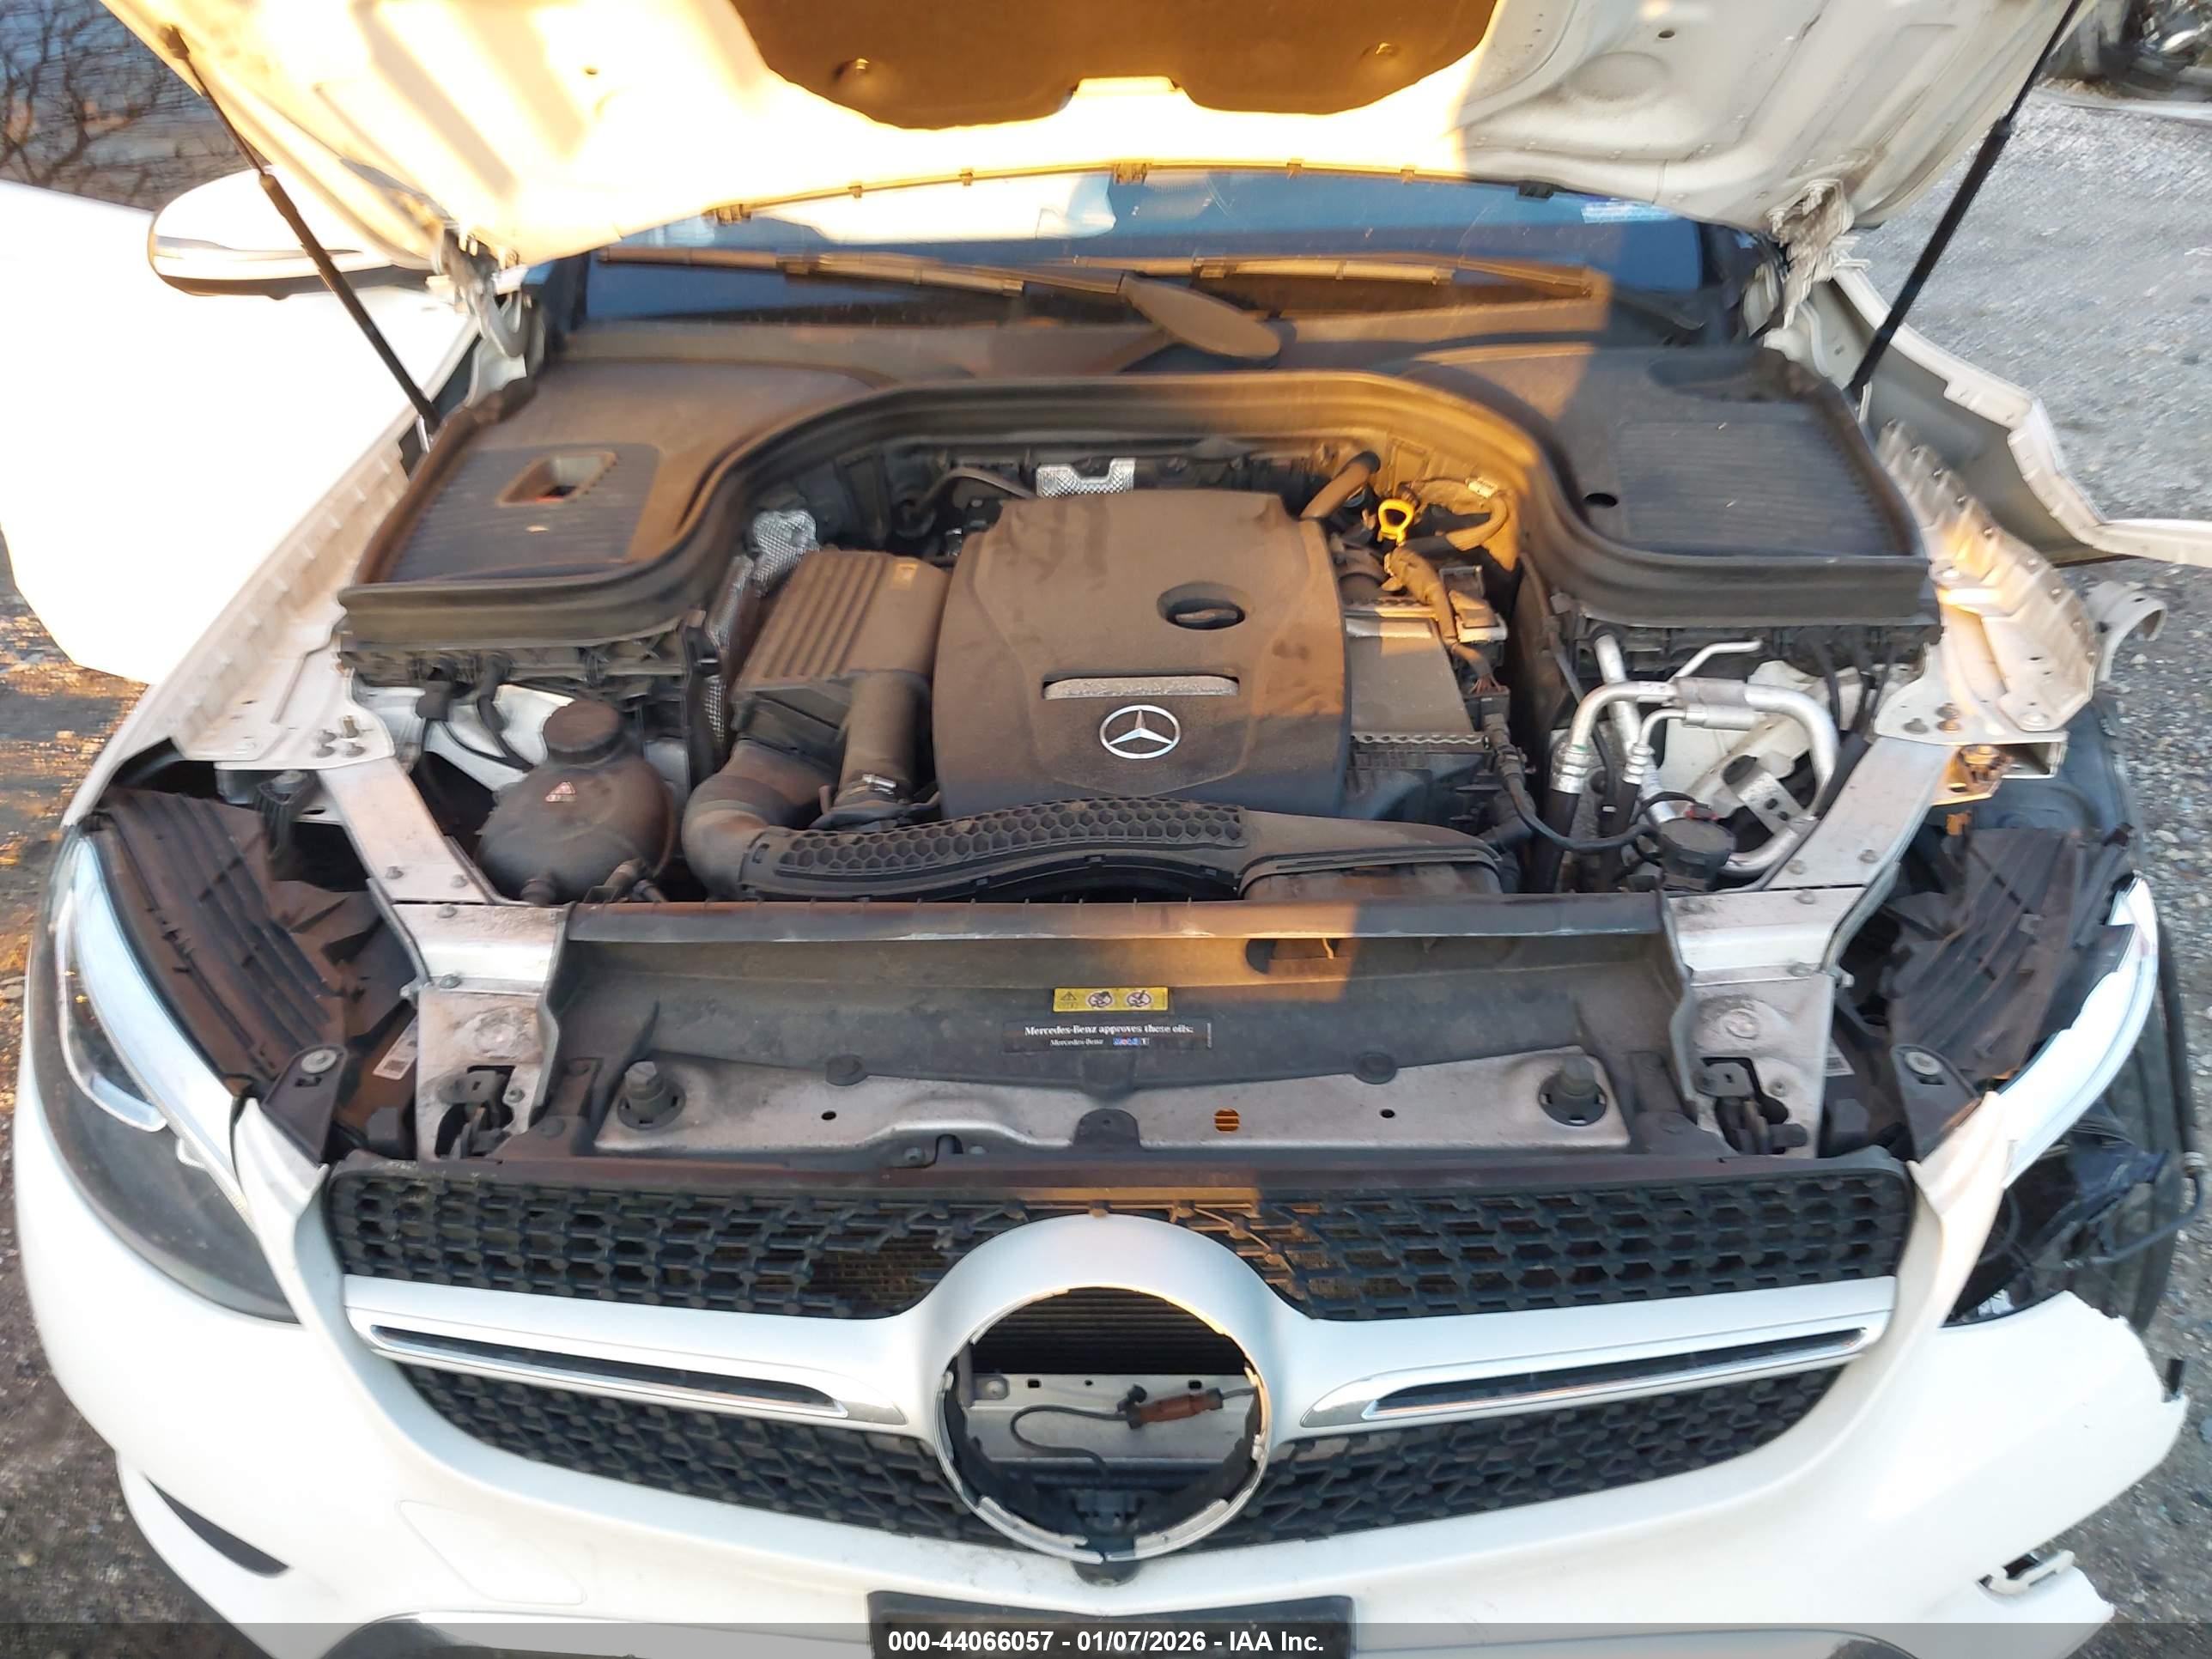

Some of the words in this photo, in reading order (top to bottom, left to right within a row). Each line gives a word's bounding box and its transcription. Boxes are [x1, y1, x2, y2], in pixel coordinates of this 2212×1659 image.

[1024, 1025, 1097, 1036] Mercedes-Benz
[1099, 1025, 1142, 1036] approves
[1145, 1024, 1170, 1034] these
